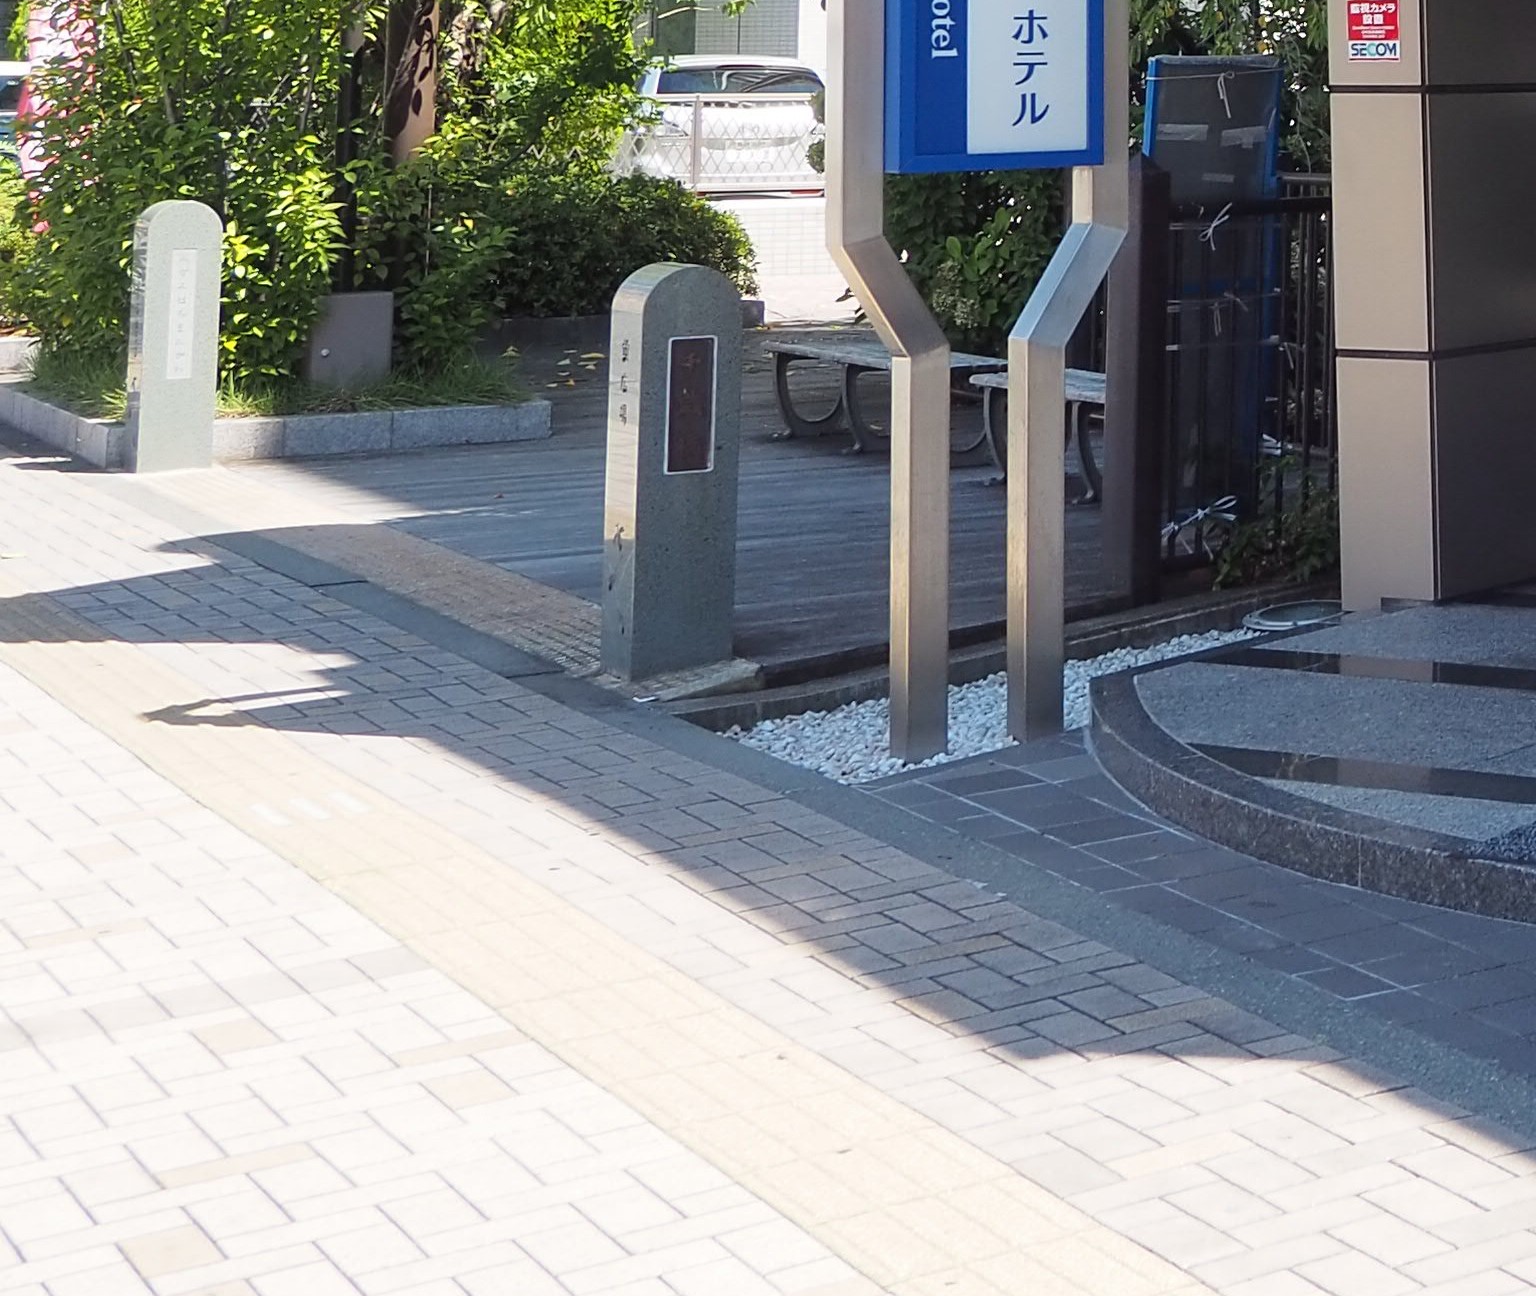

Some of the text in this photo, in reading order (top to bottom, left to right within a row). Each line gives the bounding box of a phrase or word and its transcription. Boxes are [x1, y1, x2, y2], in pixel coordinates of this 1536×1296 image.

[1011, 9, 1050, 127] ホテル
[1351, 43, 1397, 56] SECOM
